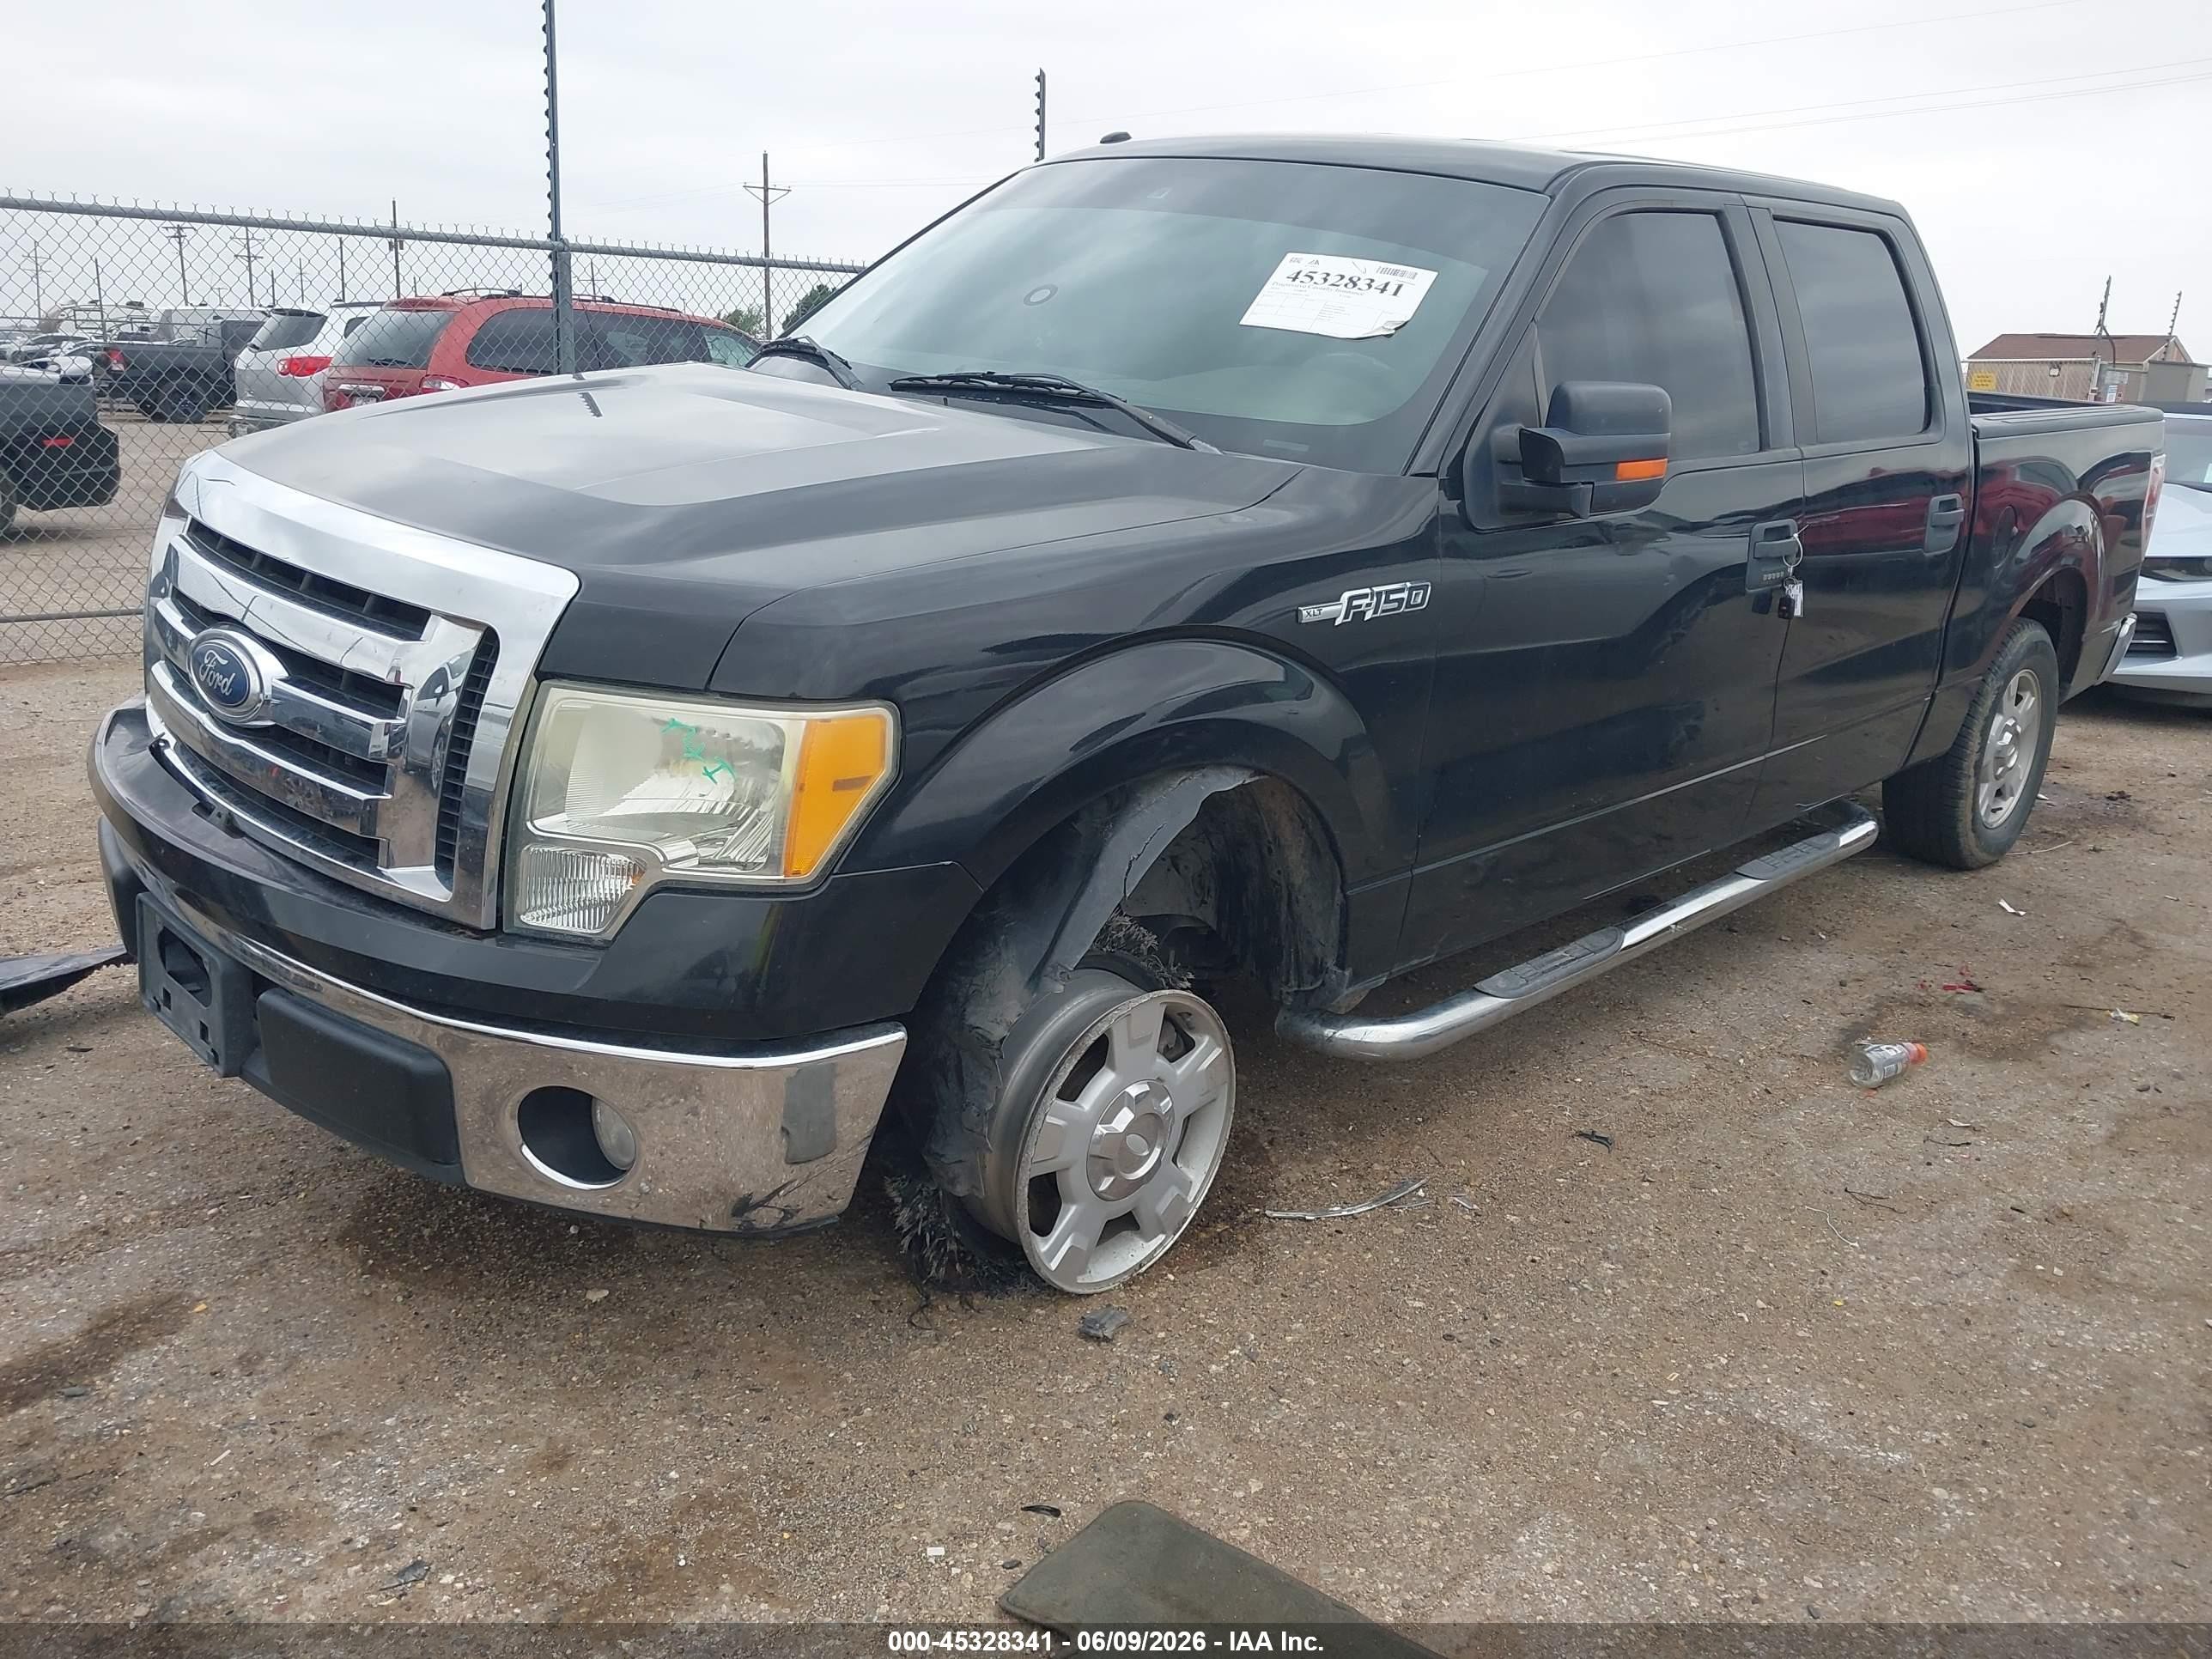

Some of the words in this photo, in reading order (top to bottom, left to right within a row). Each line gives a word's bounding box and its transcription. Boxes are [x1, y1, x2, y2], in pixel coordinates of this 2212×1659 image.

[1286, 269, 1404, 296] 45328341
[1304, 608, 1323, 618] XLT
[198, 649, 236, 696] Ford
